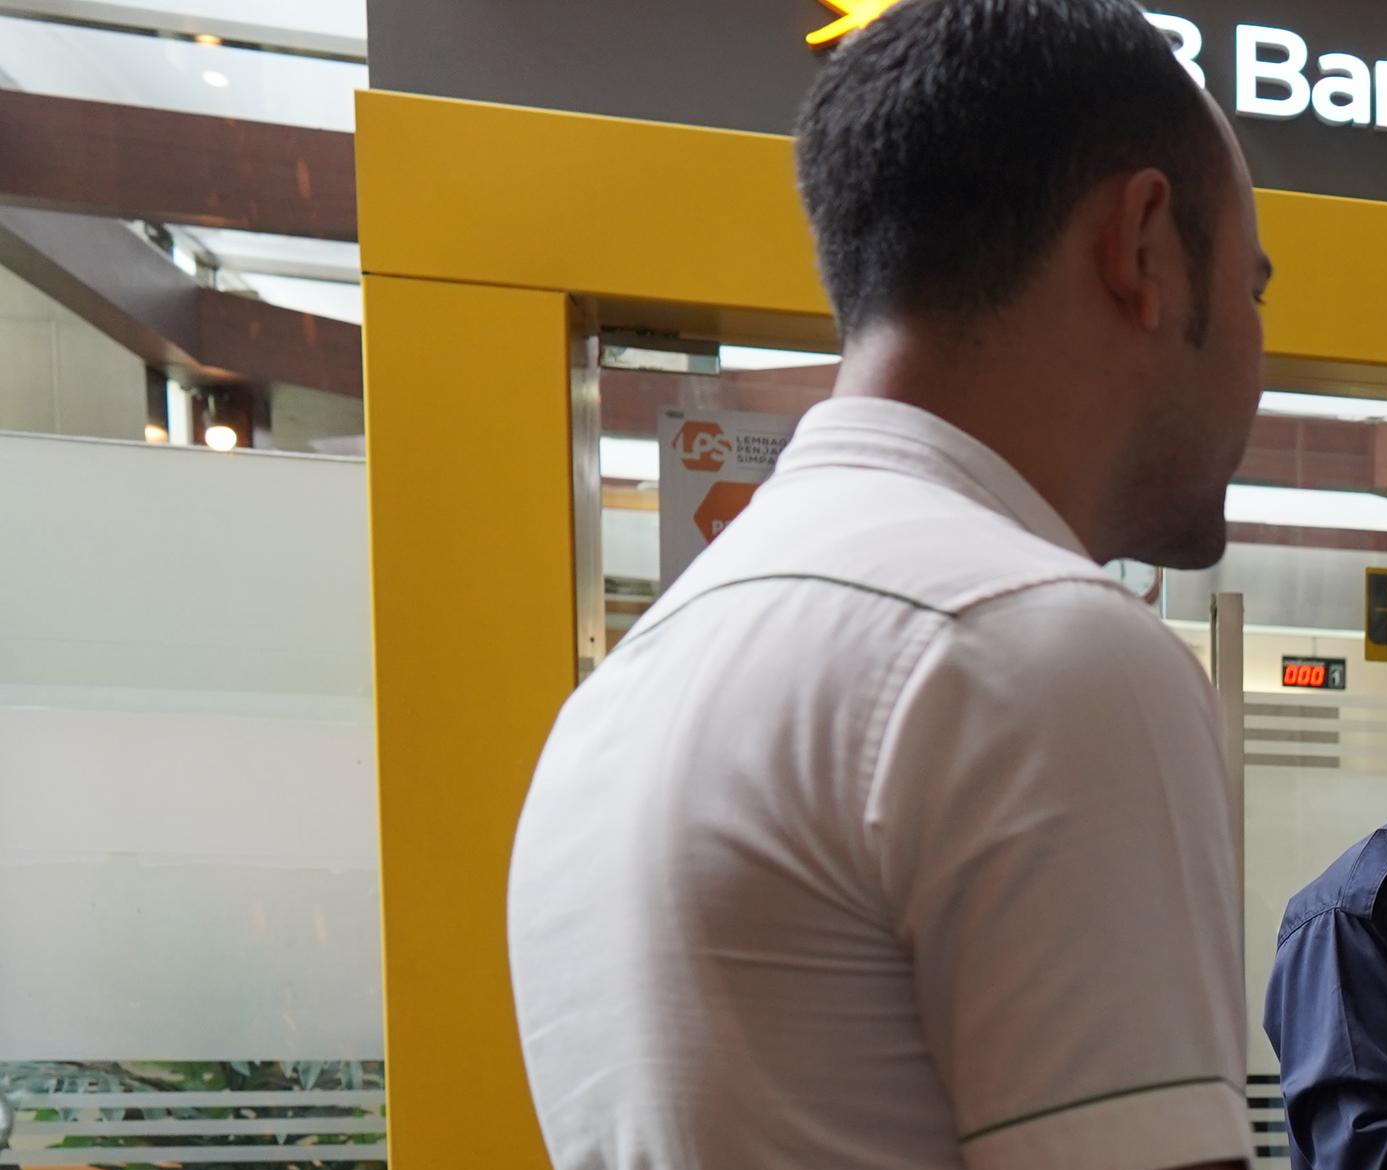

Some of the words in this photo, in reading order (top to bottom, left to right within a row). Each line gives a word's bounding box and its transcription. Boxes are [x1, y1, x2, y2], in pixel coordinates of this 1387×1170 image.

[1143, 12, 1206, 89] B
[679, 430, 731, 463] LPS
[736, 435, 787, 447] LEMBAG
[737, 445, 781, 455] PENJA
[737, 455, 775, 465] SIMPA
[1283, 664, 1326, 687] 000
